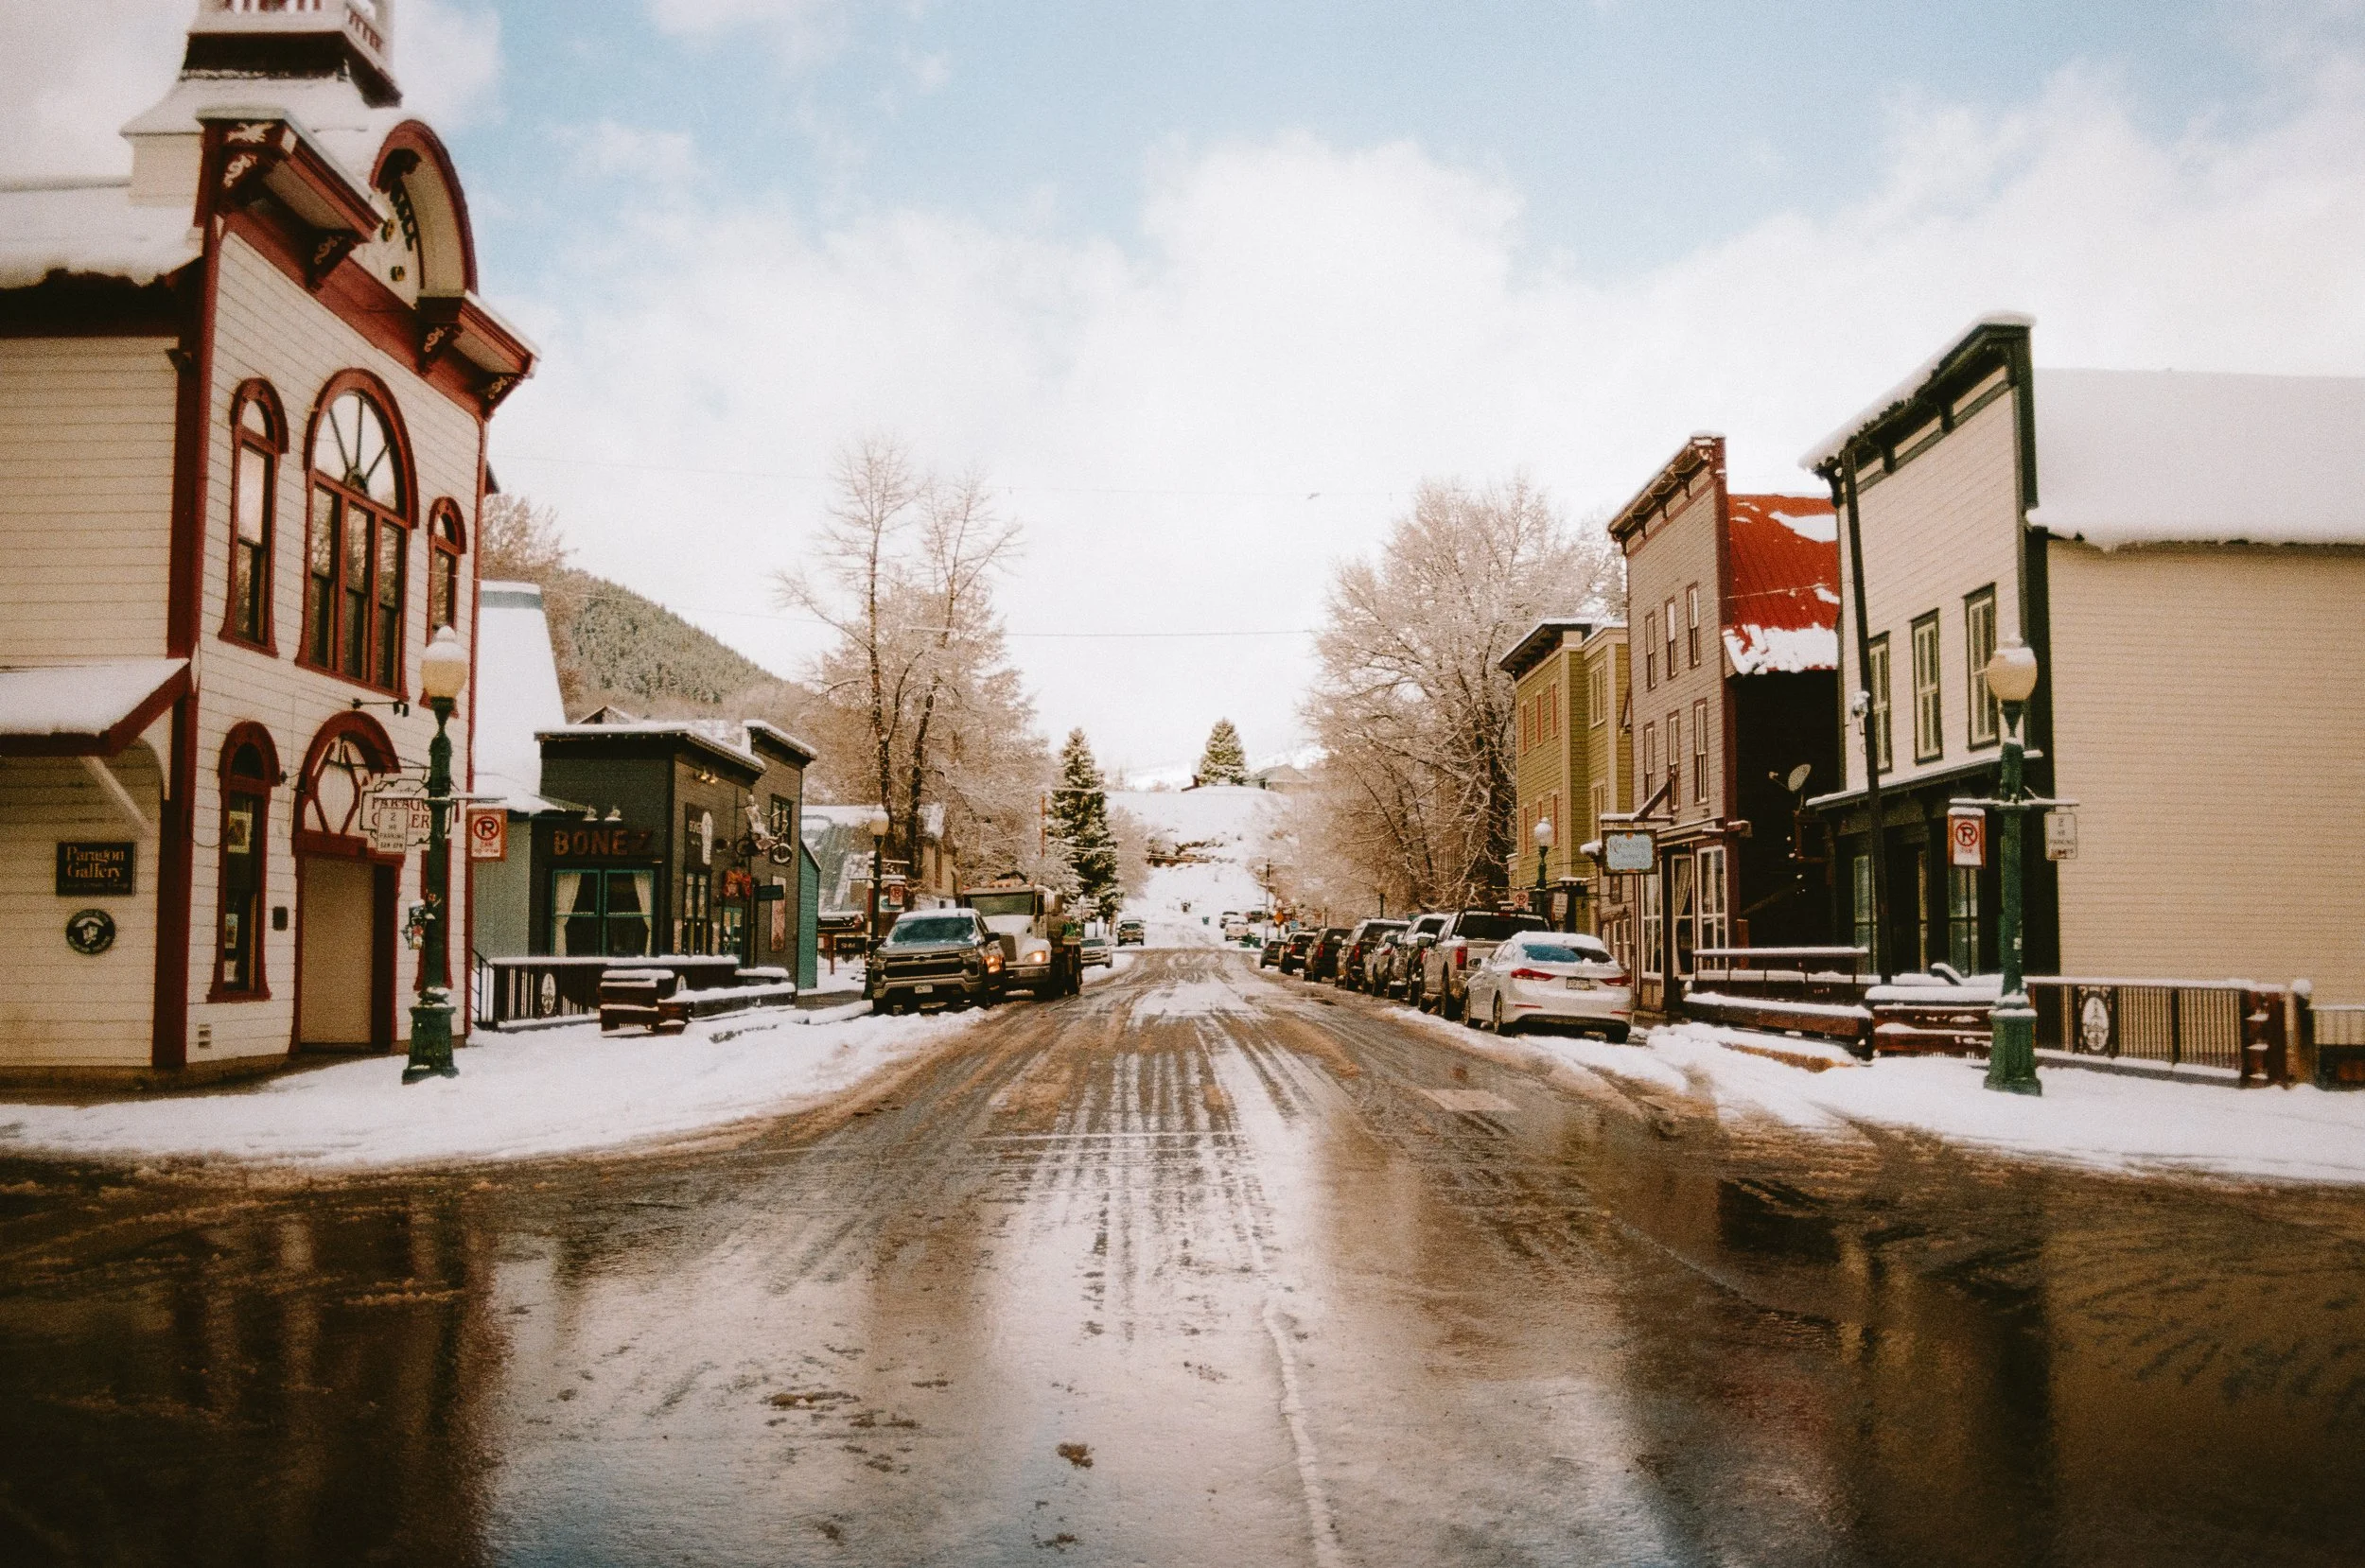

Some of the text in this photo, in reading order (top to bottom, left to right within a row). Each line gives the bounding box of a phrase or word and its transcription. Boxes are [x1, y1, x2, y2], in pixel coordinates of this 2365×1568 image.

[390, 812, 396, 822] 2
[66, 846, 124, 862] Paragon
[66, 862, 123, 881] Gallery
